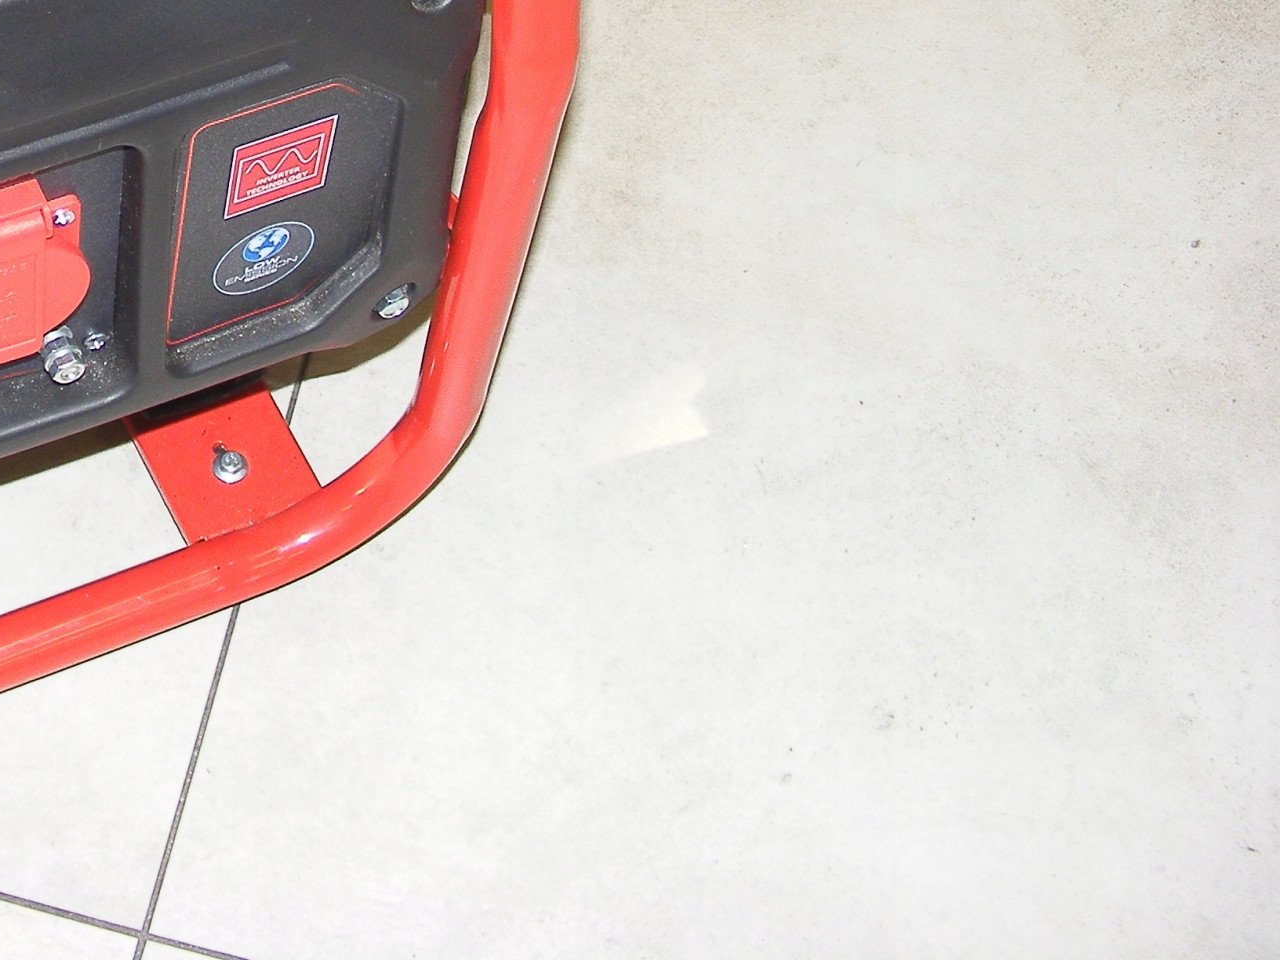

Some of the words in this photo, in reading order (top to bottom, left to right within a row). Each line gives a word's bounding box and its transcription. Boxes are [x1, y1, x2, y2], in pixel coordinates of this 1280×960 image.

[246, 171, 308, 196] TECHNOLOGY
[256, 166, 301, 186] INVERTER
[245, 256, 282, 274] LOW
